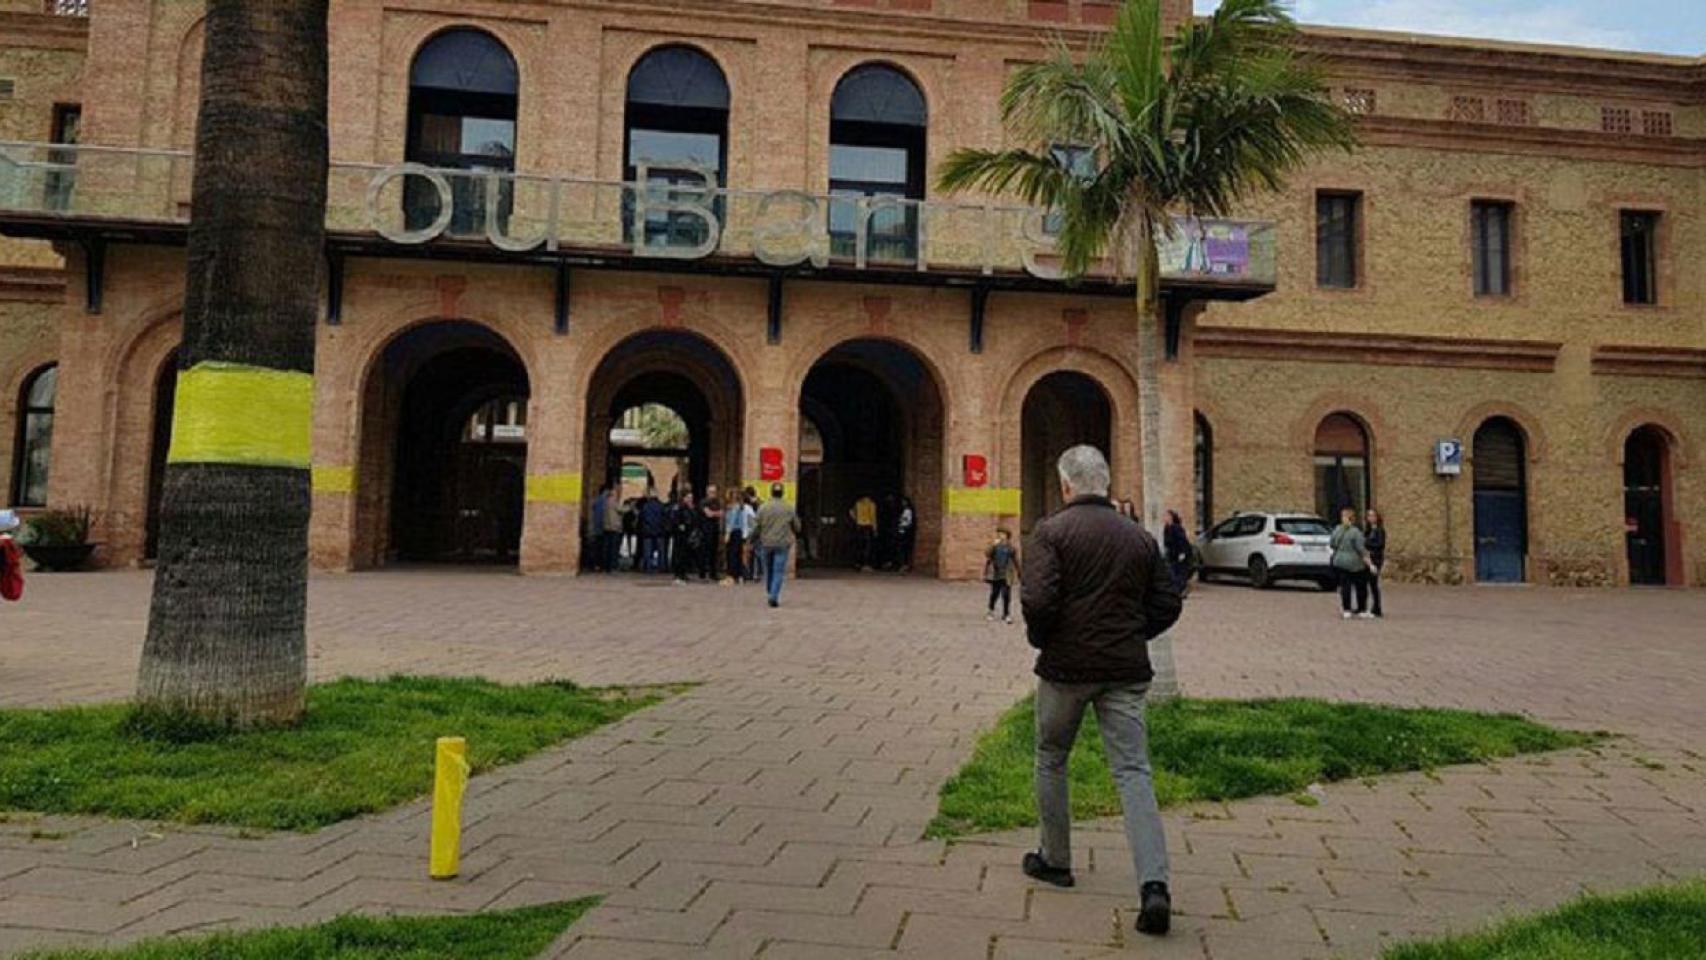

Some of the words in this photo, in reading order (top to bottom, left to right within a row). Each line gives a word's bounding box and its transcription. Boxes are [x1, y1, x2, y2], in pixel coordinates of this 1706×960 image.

[760, 447, 784, 480] B
[1440, 442, 1455, 462] P
[963, 454, 986, 487] B
